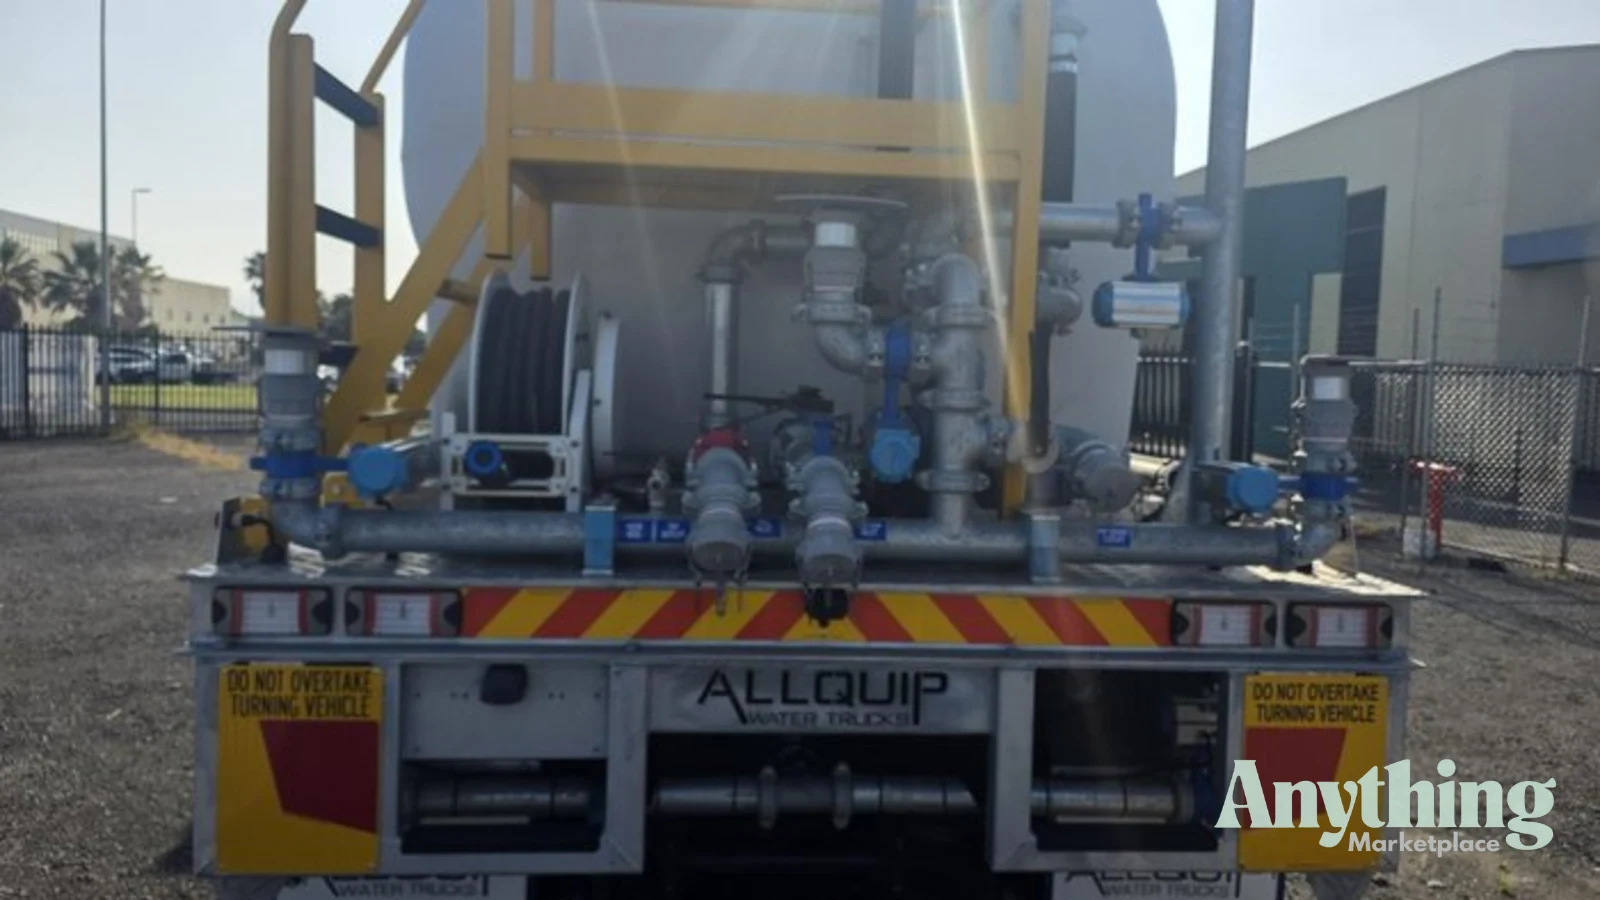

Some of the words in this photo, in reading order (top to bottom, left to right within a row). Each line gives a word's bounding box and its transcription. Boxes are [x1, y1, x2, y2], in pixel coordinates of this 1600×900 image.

[227, 669, 249, 692] DO
[255, 669, 284, 692] NOT
[291, 669, 371, 694] OVERTAKE
[1252, 682, 1273, 701] DO
[1276, 682, 1305, 701] NOT
[1307, 682, 1379, 702] OVERTAKE
[231, 694, 301, 717] TURNING
[304, 695, 369, 718] VEHICLE
[697, 669, 949, 726] ALLQUIP
[748, 711, 818, 726] WATER
[825, 711, 909, 727] TRUCKS
[1256, 703, 1315, 722] TURNING
[1319, 704, 1376, 723] VEHICLE
